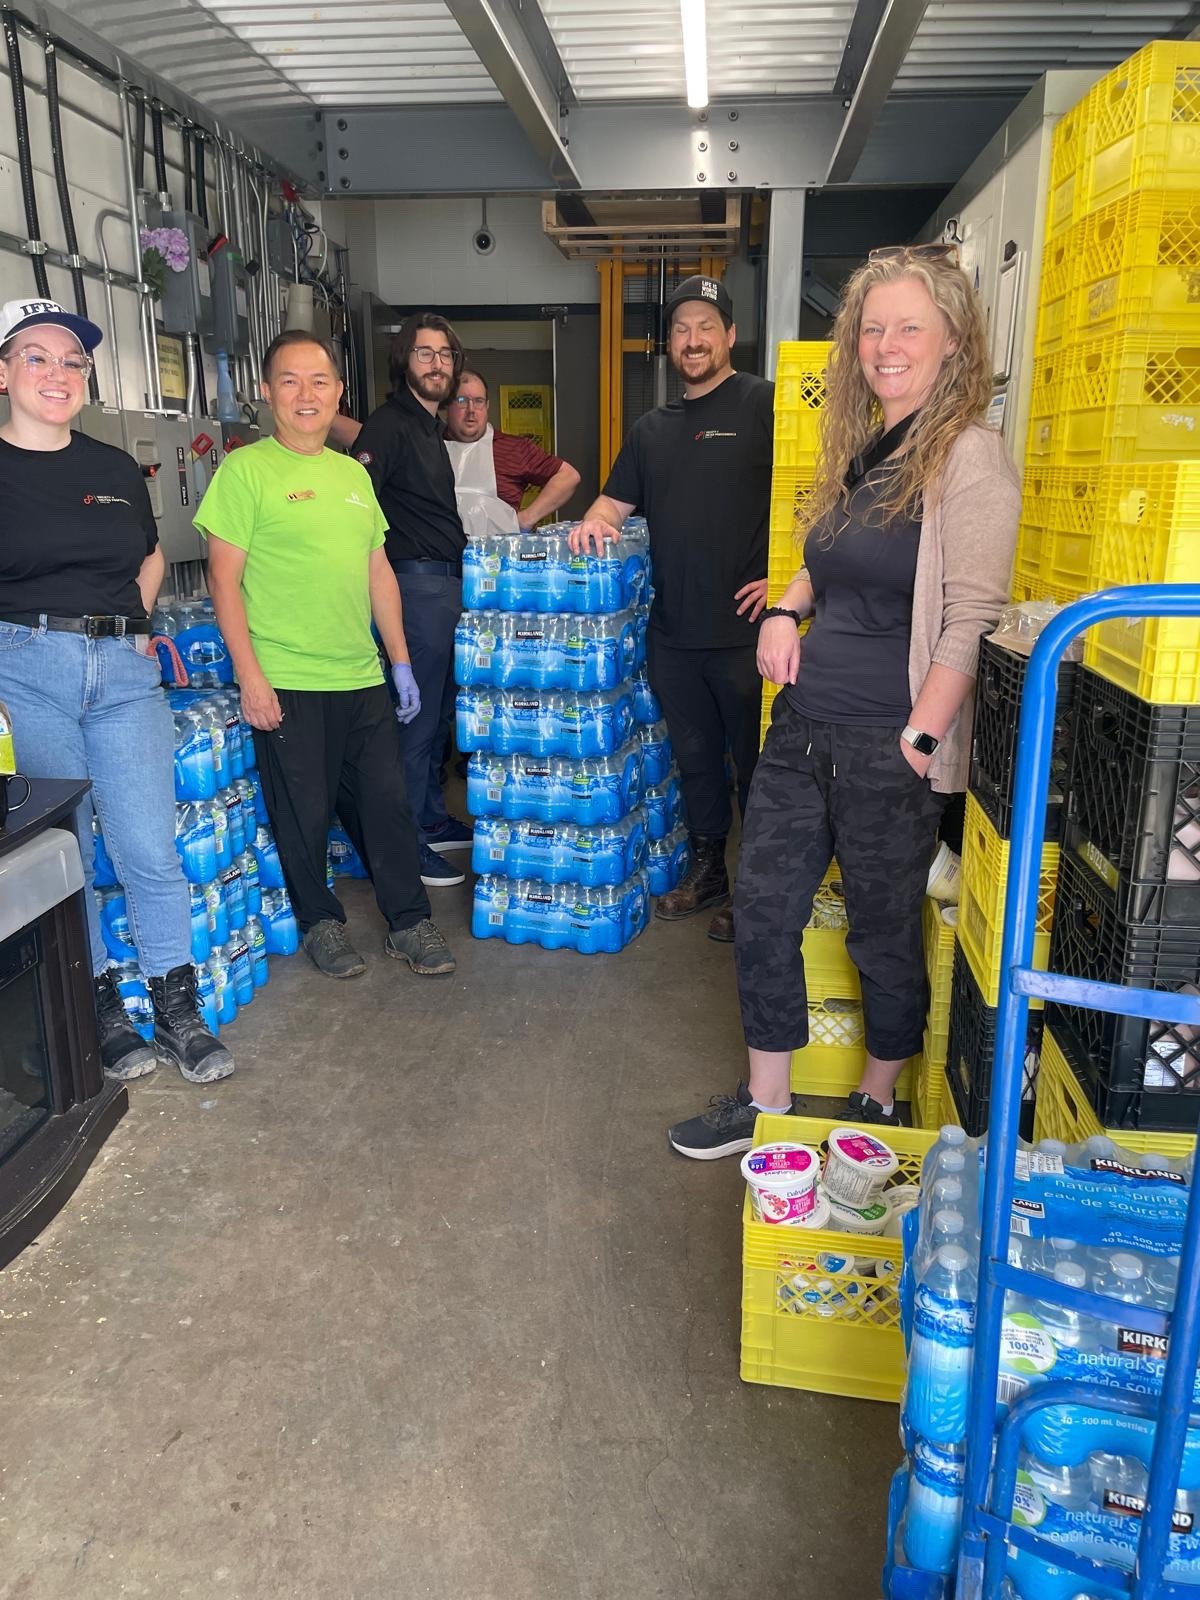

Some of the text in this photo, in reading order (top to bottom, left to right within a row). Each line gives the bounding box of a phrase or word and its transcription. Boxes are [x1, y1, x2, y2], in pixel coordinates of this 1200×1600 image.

[1095, 1158, 1182, 1181] KIRKLAND
[1055, 1179, 1118, 1194] natural
[1012, 1199, 1041, 1209] LAND
[1043, 1191, 1076, 1201] eau
[1080, 1198, 1102, 1208] de
[1109, 1202, 1169, 1217] source
[1133, 1234, 1153, 1245] 500
[1009, 1341, 1040, 1353] 100%
[1122, 1331, 1168, 1350] KIRK
[1077, 1353, 1140, 1370] natural
[1082, 1417, 1099, 1425] 500
[1115, 1420, 1148, 1434] bottles
[1065, 1510, 1123, 1528] natural
[1046, 1567, 1058, 1575] 40
